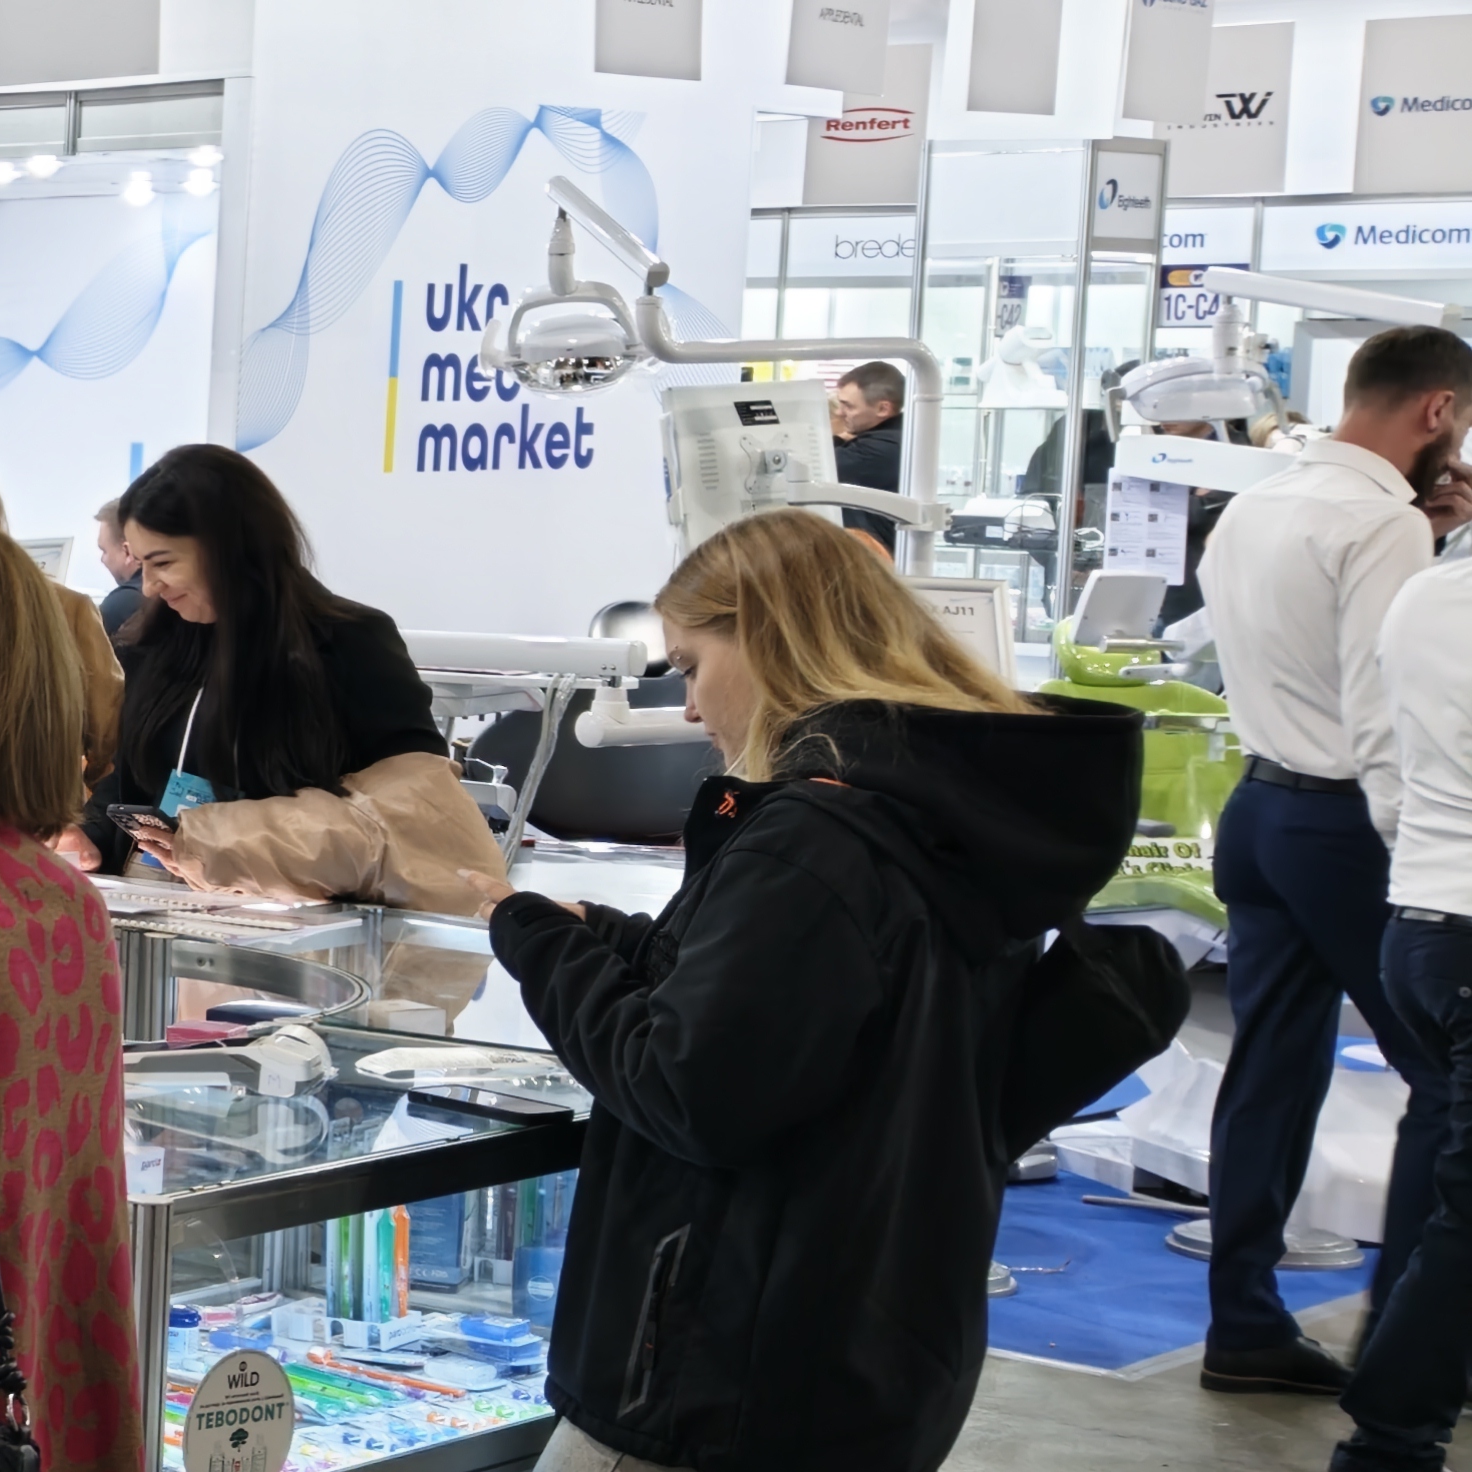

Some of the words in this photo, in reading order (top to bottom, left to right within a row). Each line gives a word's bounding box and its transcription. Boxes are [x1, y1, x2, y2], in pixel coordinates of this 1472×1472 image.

[826, 118, 911, 131] Renfert
[1354, 225, 1471, 245] Medicom
[426, 263, 509, 332] ukr
[1165, 294, 1221, 321] 1C-C4
[417, 403, 594, 472] market
[228, 1371, 259, 1389] WILD
[196, 1403, 285, 1430] TEBODONT
